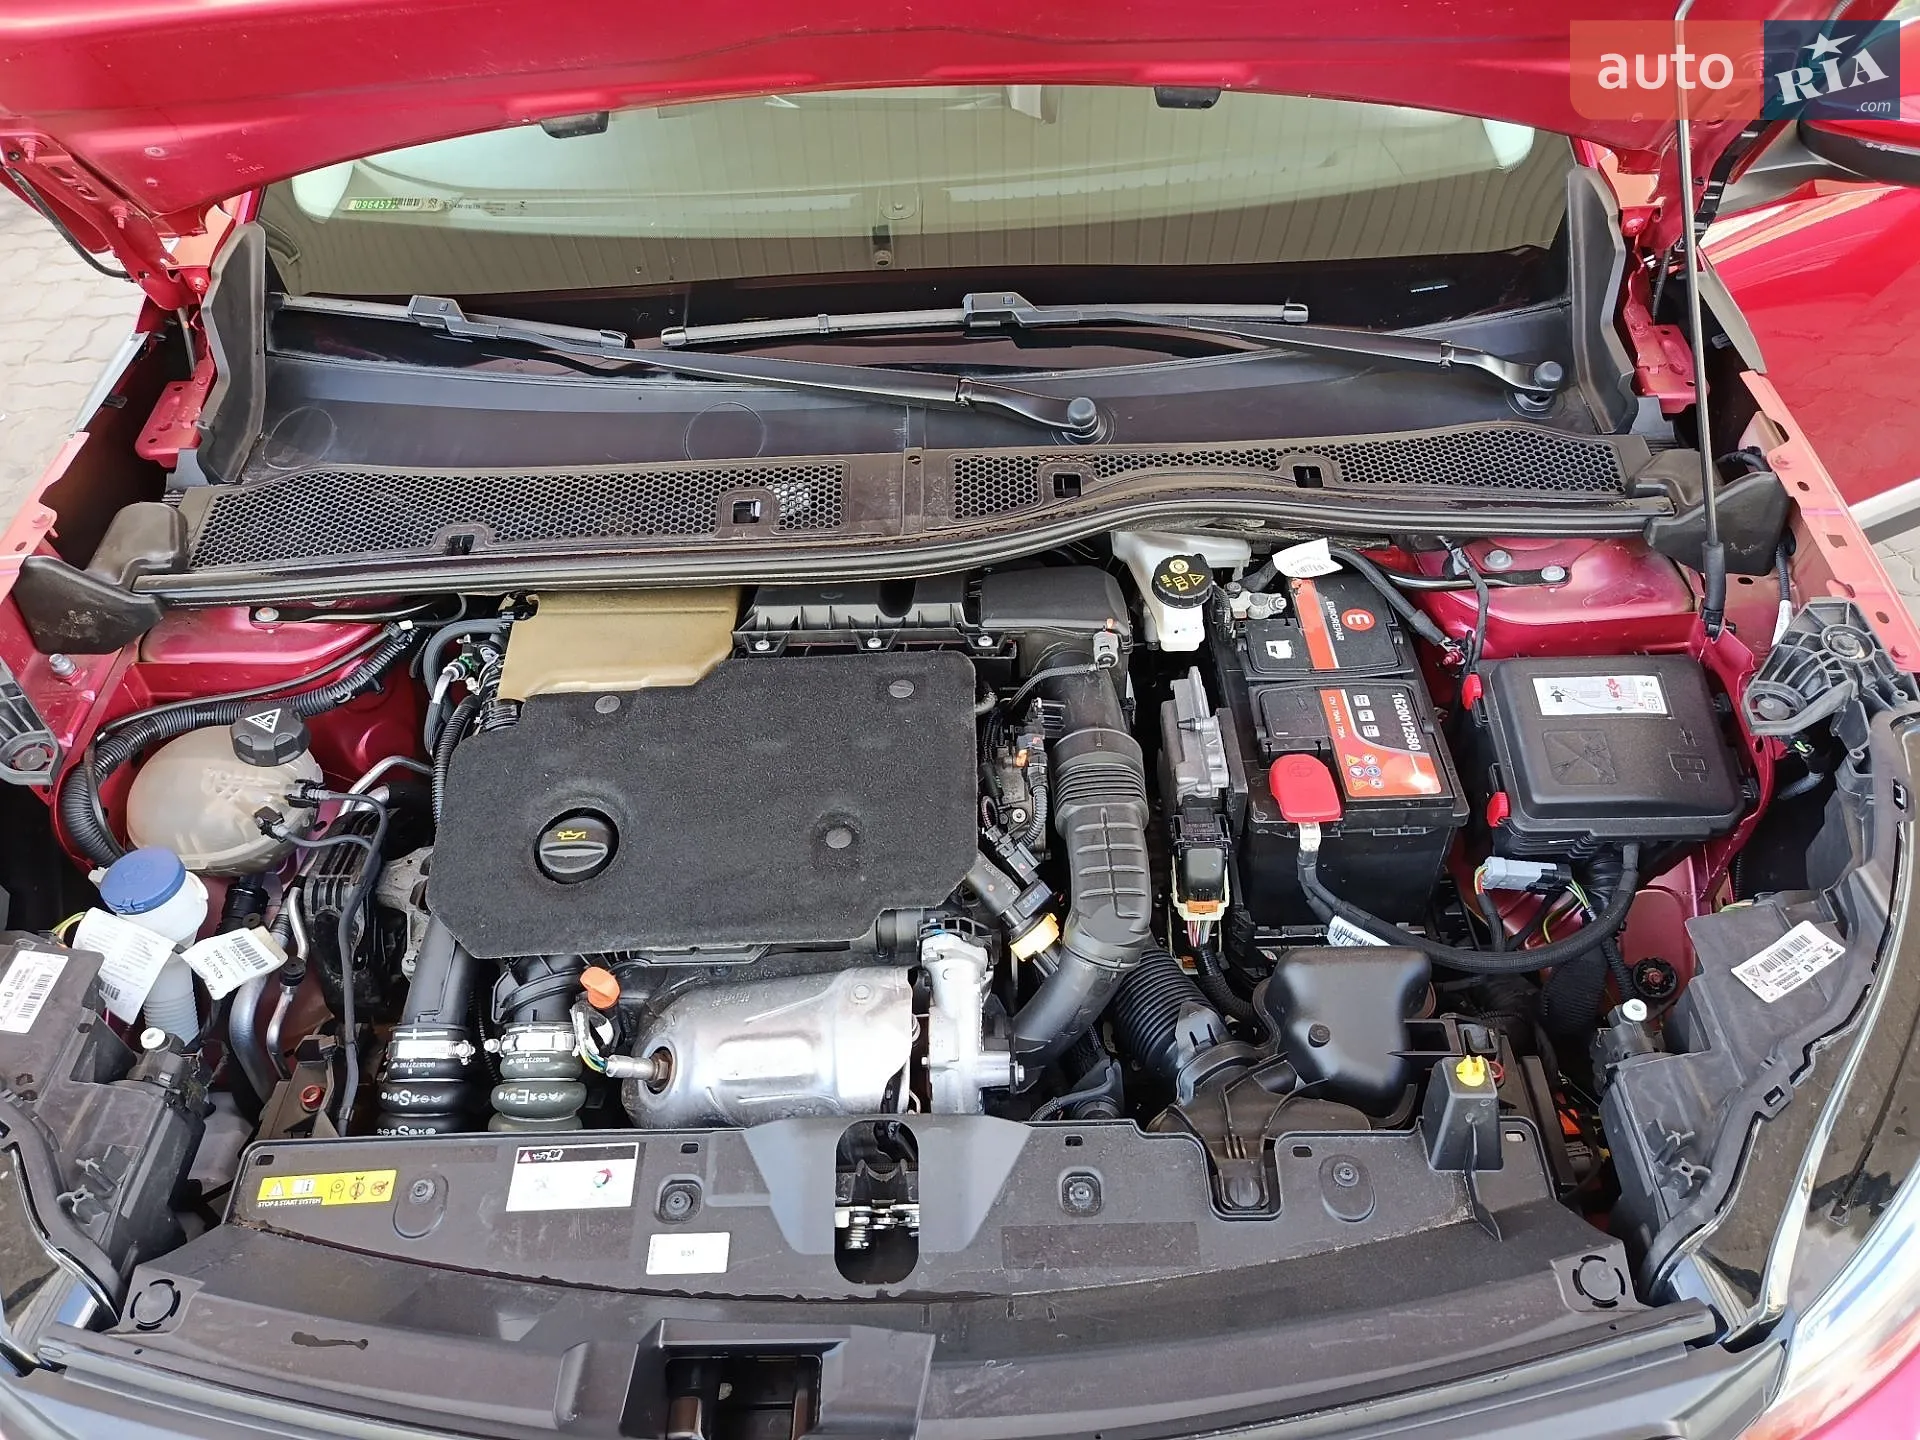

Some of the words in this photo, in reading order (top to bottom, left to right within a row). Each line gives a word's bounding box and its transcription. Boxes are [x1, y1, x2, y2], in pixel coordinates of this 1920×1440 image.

[1325, 600, 1345, 642] EUROREPAR
[1391, 692, 1422, 751] 1620012580
[257, 1200, 273, 1208] STOP
